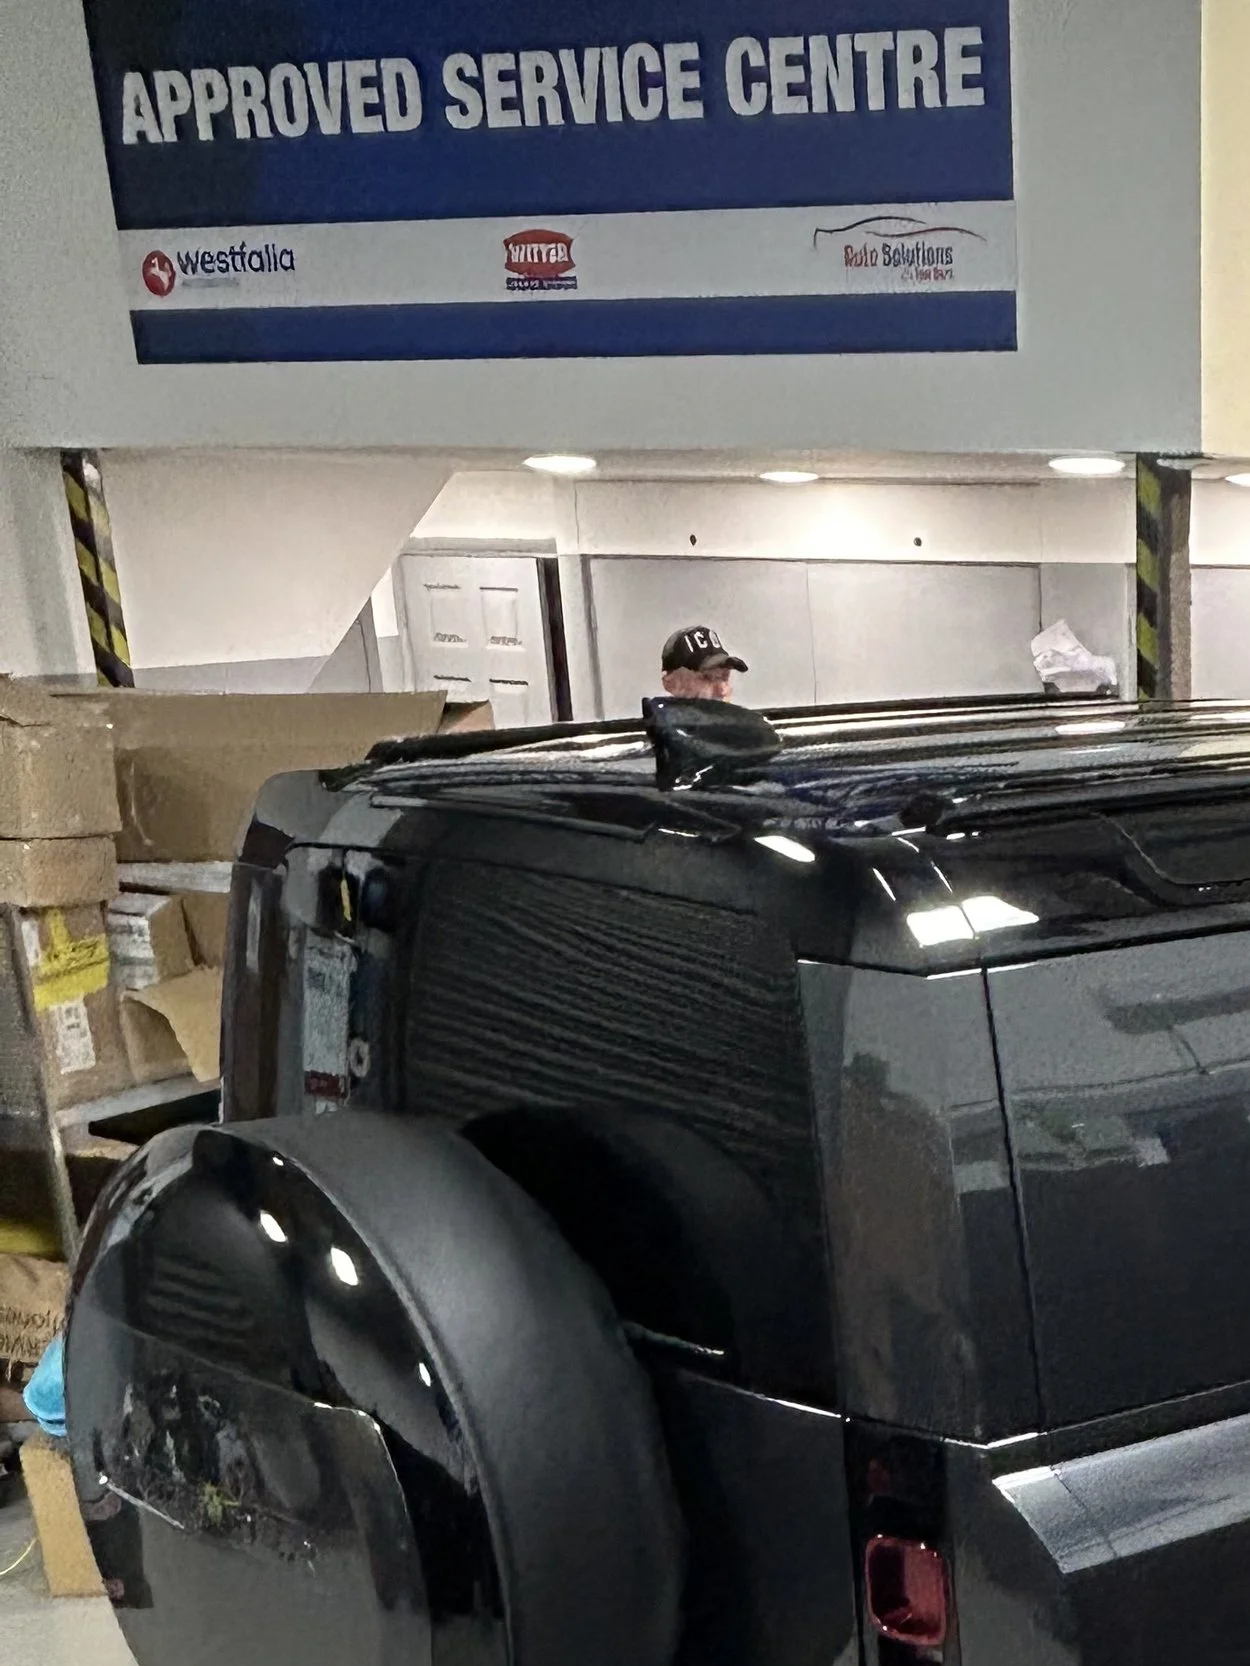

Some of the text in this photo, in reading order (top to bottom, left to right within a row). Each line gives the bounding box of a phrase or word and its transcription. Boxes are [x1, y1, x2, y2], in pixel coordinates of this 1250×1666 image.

[122, 26, 986, 146] APPROVED SERVICE CENTRE
[881, 240, 954, 267] Solutions
